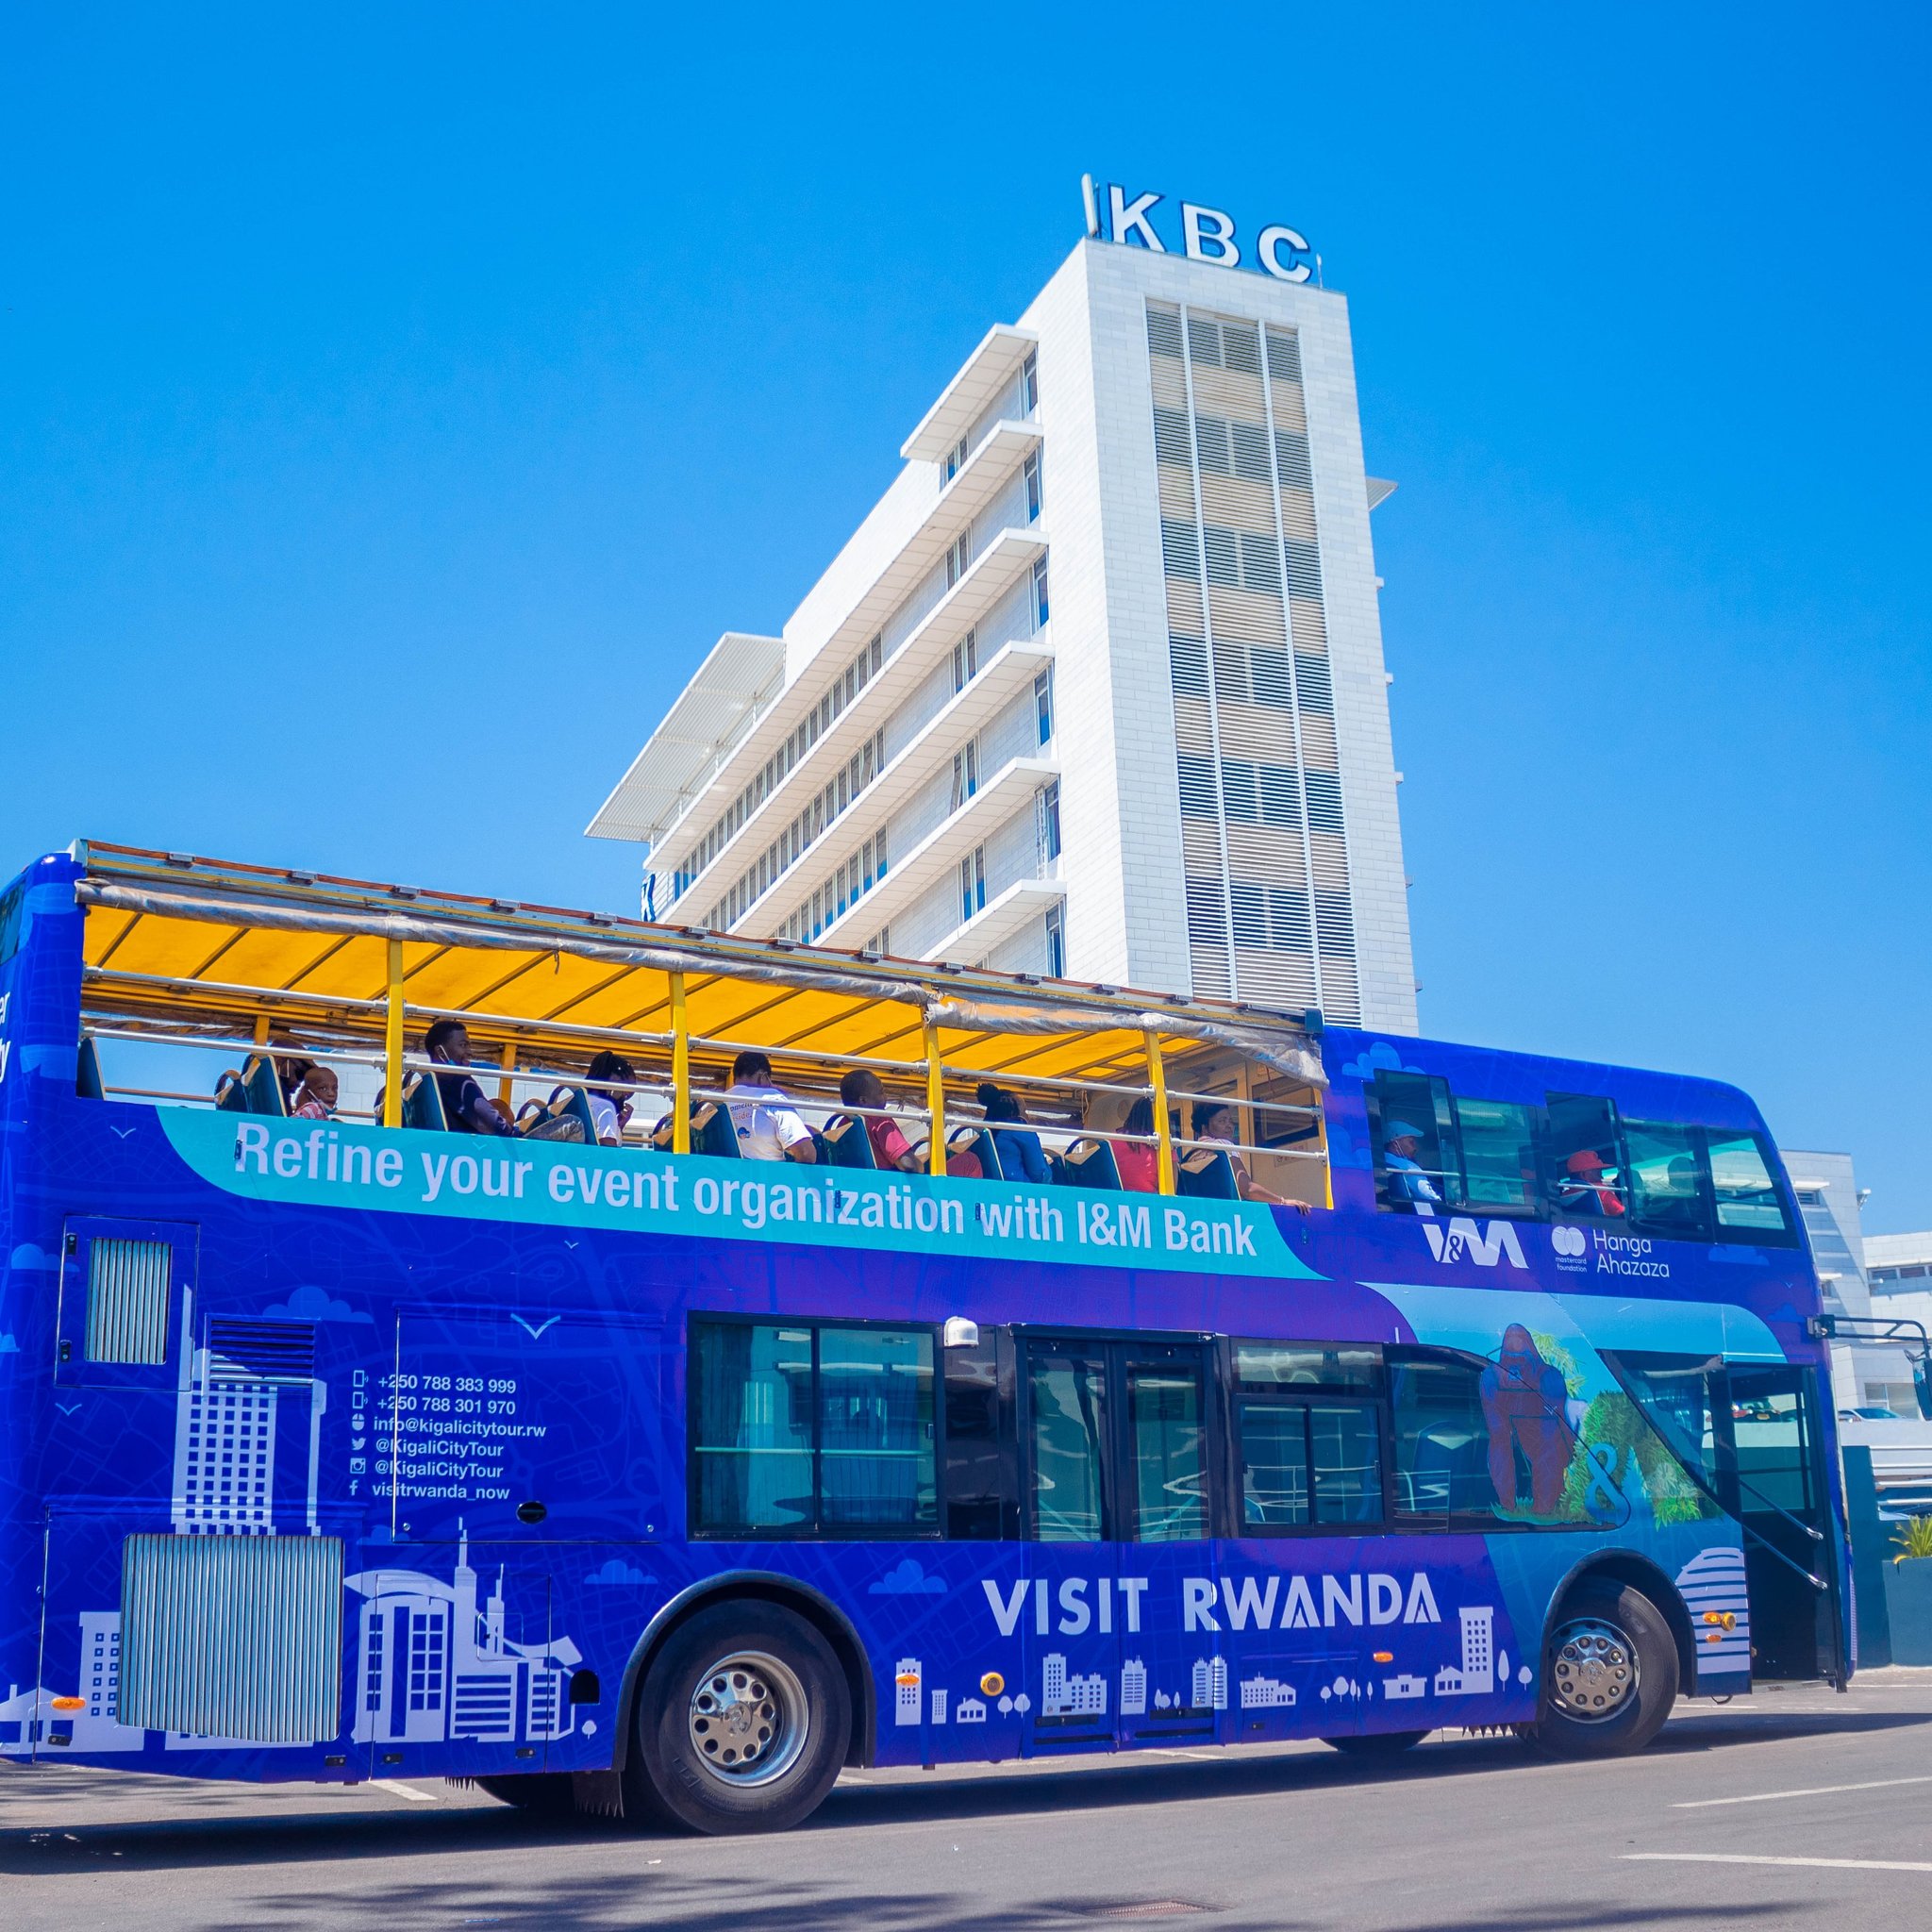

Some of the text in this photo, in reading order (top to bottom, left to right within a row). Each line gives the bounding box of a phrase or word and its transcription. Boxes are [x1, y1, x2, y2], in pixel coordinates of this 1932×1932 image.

[1108, 182, 1310, 283] KBC
[235, 1122, 1257, 1257] Refine your event organization with I&M Bank
[1592, 1228, 1652, 1257] Hanga
[1555, 1256, 1587, 1265] mastercard
[1557, 1264, 1588, 1273] foundation
[1596, 1253, 1670, 1277] Ahazaza
[378, 1374, 516, 1394] +250 788 383 999
[377, 1396, 516, 1415] +250 788 301 970
[374, 1416, 546, 1438] info@kigalicitytour.rw
[375, 1438, 504, 1458] @KigaliCityTour
[375, 1459, 504, 1479] @KigaliCityTour
[372, 1482, 510, 1502] visitrwanda_now
[981, 1572, 1441, 1636] VISIT RWANDA
